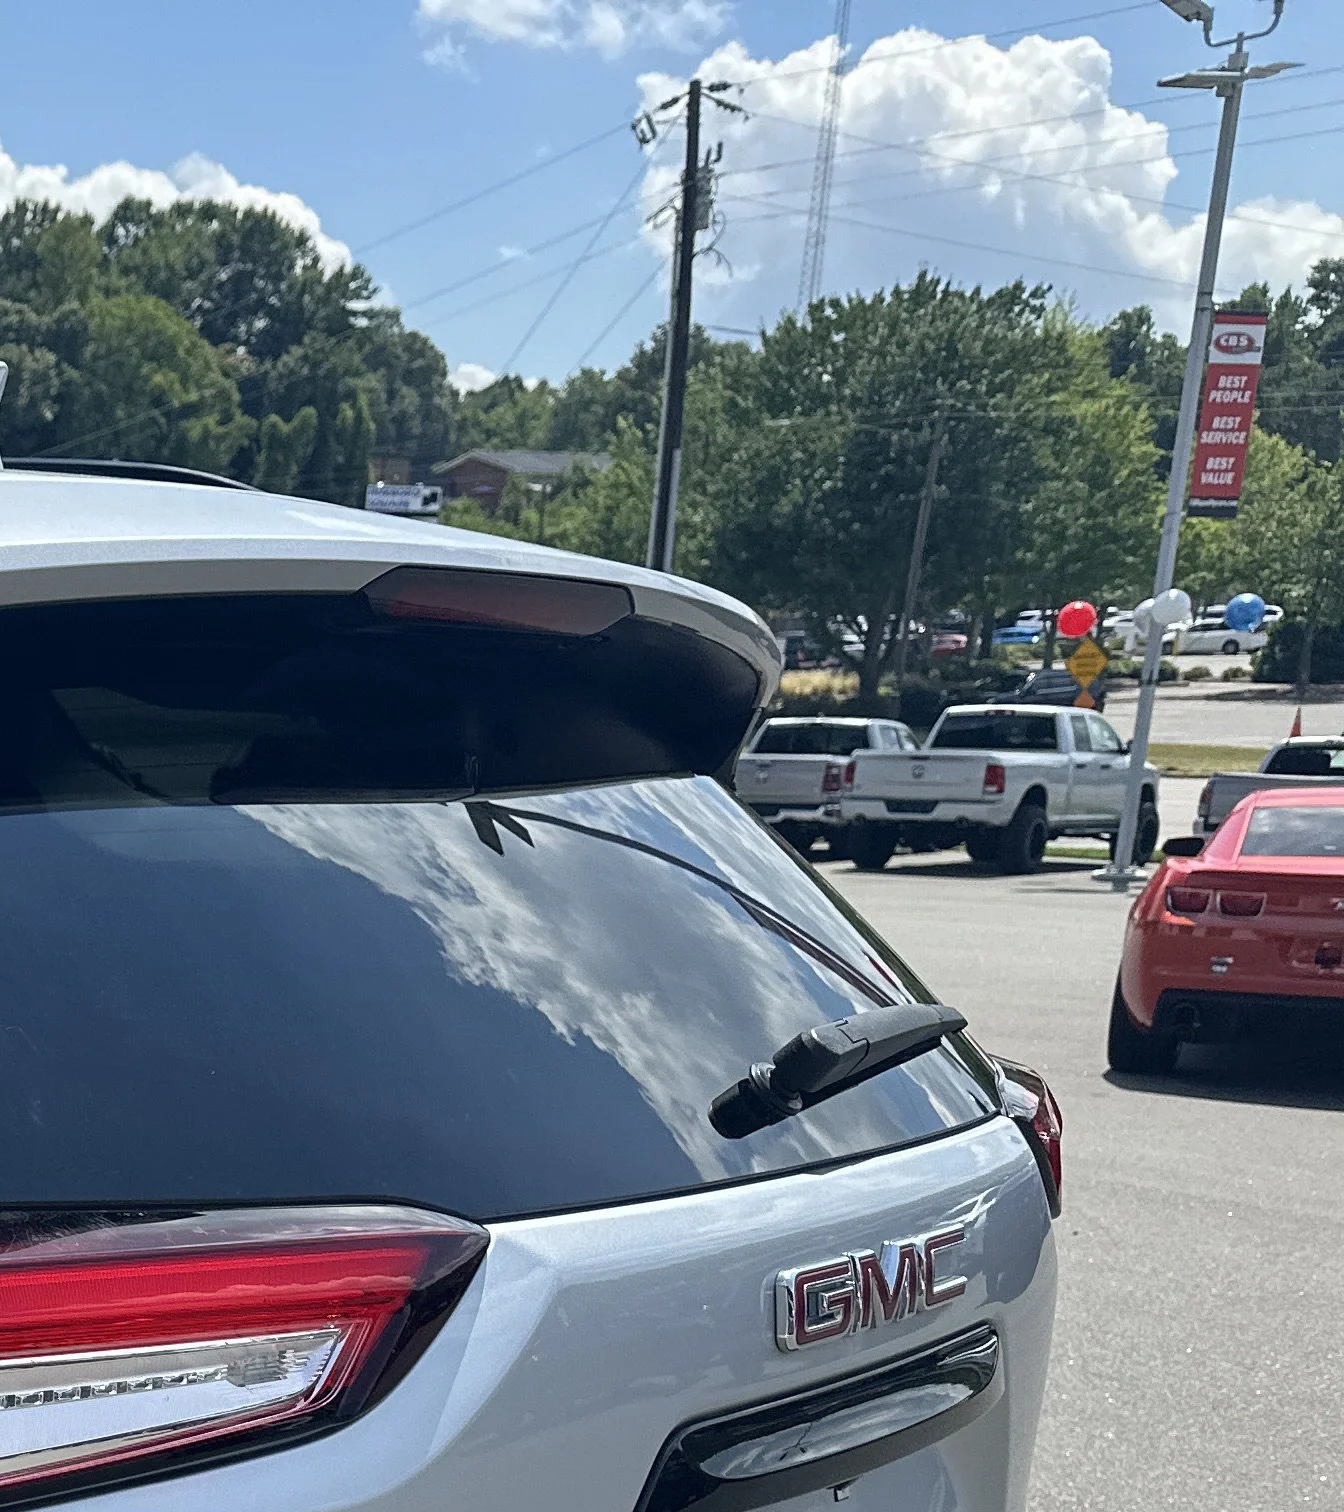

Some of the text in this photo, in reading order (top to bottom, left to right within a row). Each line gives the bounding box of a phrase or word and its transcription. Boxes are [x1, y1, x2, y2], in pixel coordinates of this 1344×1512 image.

[1218, 375, 1248, 389] BEST
[1208, 390, 1252, 403] PEOPLE
[1212, 416, 1242, 430] BEST
[1200, 431, 1247, 445] SERVICE
[1206, 457, 1236, 470] BEST
[1200, 472, 1235, 485] VALUE
[775, 1223, 968, 1352] GMC
